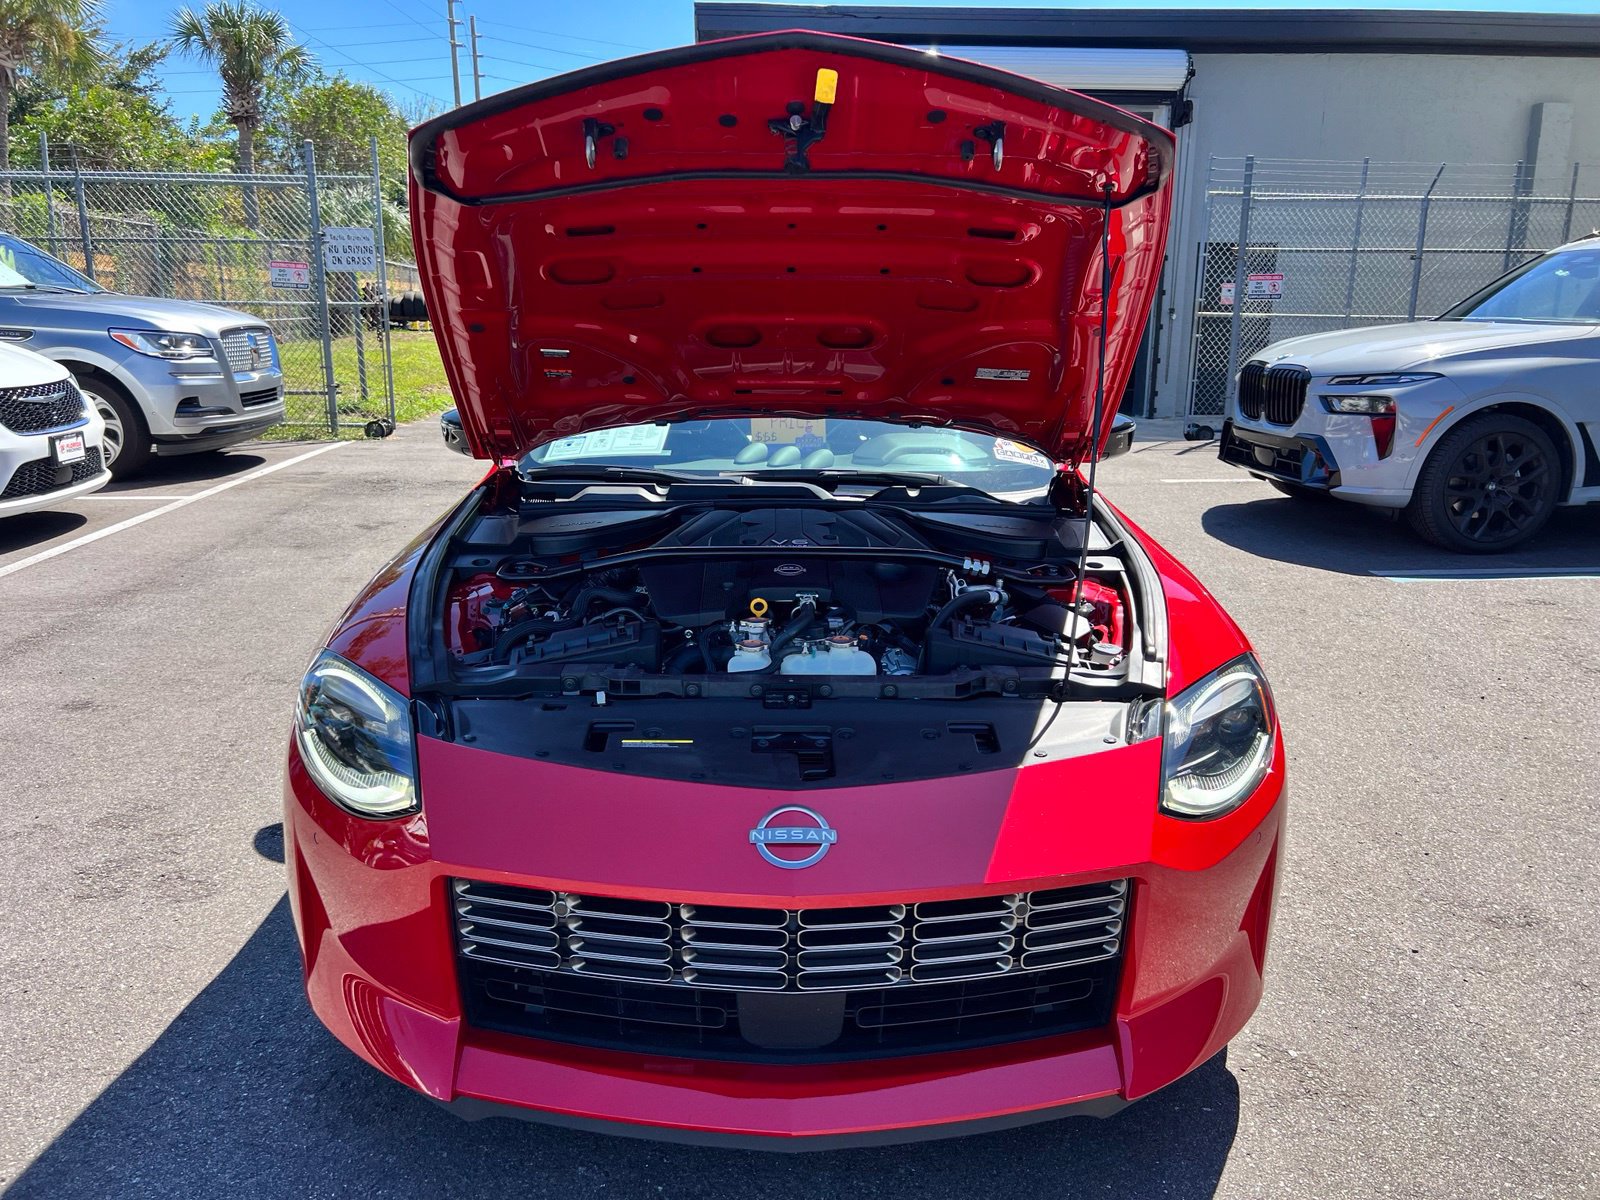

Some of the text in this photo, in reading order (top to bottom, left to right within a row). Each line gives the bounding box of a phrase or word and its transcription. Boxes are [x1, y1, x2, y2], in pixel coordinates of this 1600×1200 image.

[328, 244, 374, 254] NO DRIVING
[332, 256, 373, 265] ON GRASS
[752, 830, 834, 840] NISSAN
